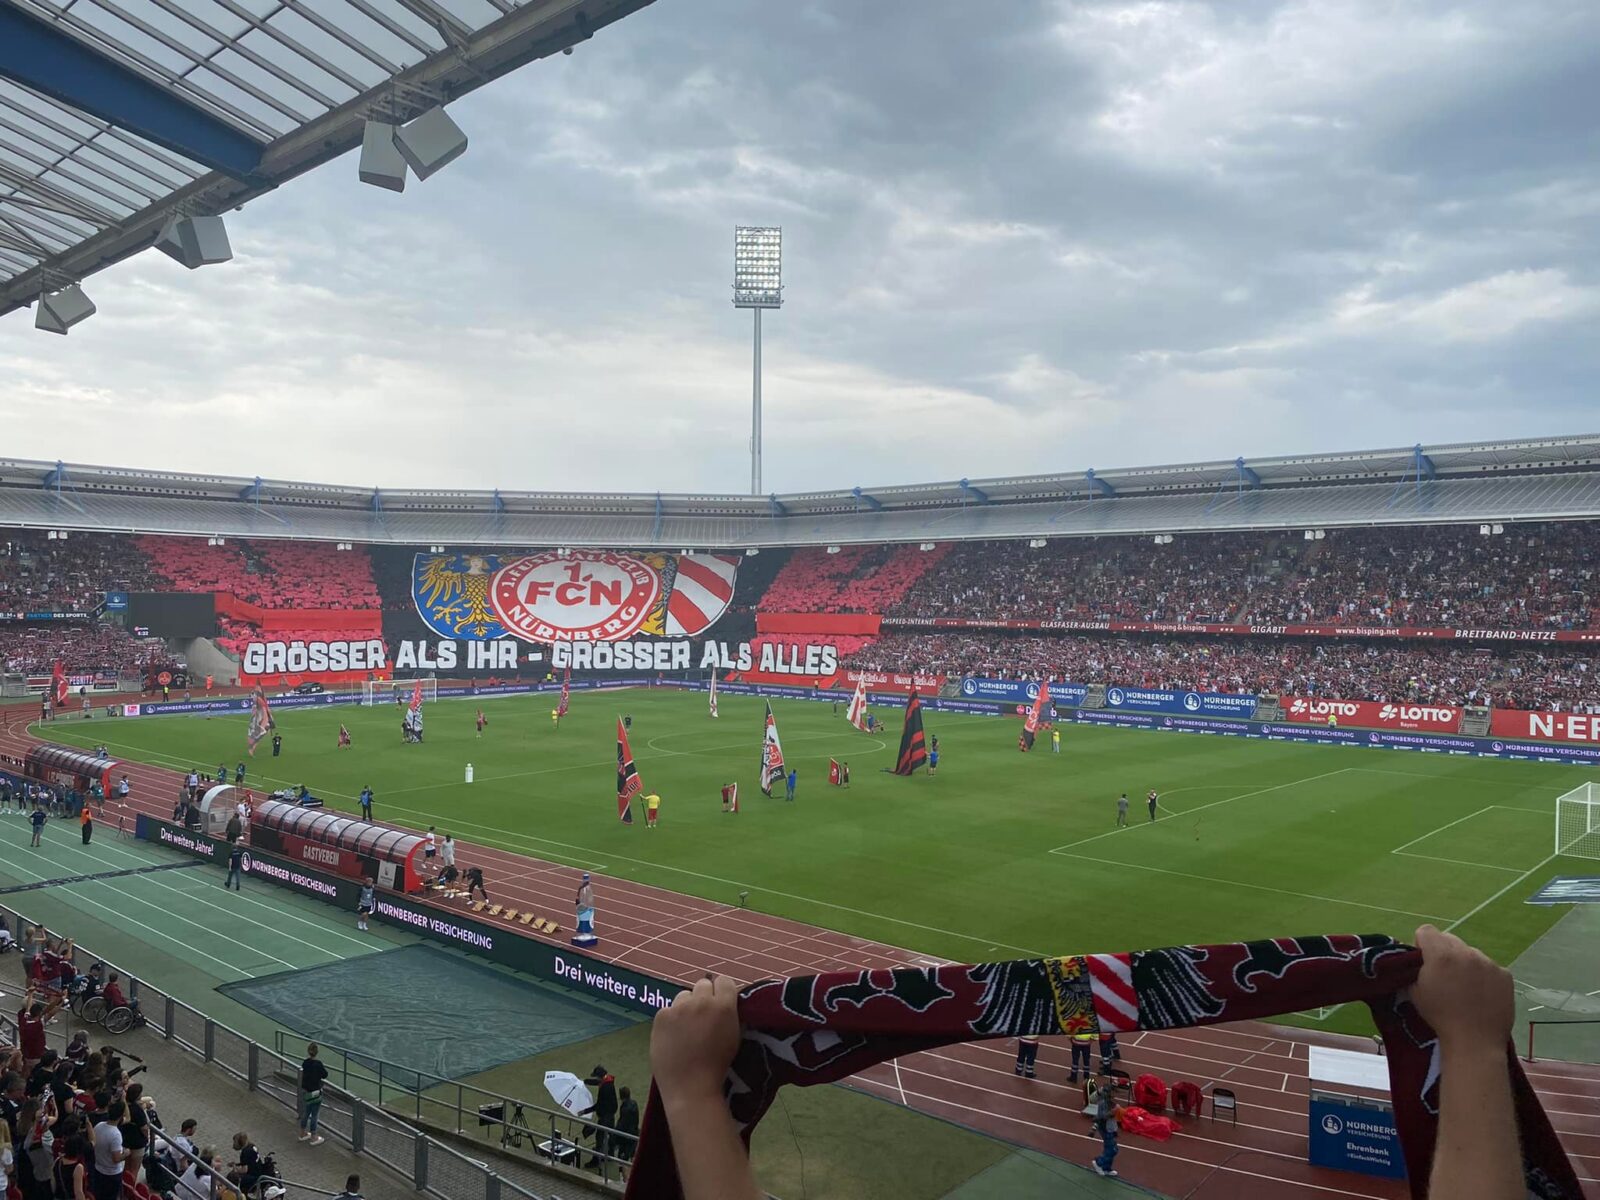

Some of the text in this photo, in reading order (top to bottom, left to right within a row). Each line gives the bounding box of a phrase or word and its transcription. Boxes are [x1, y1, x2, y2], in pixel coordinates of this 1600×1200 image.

[524, 580, 622, 606] FCN
[508, 605, 637, 641] NÜRNBERG
[1040, 620, 1110, 631] GLASFASER-AUSBAU
[1250, 625, 1287, 635] GIGABIT
[1335, 627, 1400, 638] www.bisping.net
[1455, 629, 1557, 641] BREITBAND-NETZE
[244, 640, 387, 674] GRÖSSER
[396, 640, 457, 669] ALS
[467, 640, 518, 669] IHR
[552, 640, 690, 670] GRÖSSER
[700, 640, 752, 671] ALS
[759, 643, 838, 676] ALLES
[978, 681, 1019, 691] NÜRNBERGER
[1126, 691, 1174, 702] NÜRNBERGER
[1203, 696, 1255, 707] NÜRNBERGER
[1203, 704, 1240, 712] VERSICHERUNG
[1309, 701, 1357, 717] LOTTO
[1400, 706, 1453, 723] LOTTO
[1173, 719, 1249, 731] NÜRNBERGER VERSICHERUNG
[1271, 726, 1355, 738] NÜRNBERGER VERSICHERUNG
[1381, 734, 1475, 748] NÜRNBERGER VERSICHERUNG
[1505, 744, 1554, 754] NÜRNBERGER
[160, 827, 215, 857] Drei weitere Jahre!
[303, 845, 340, 866] GASTVEREIN
[252, 859, 337, 897] NÜRNBERGER VERSICHERUNG
[377, 900, 493, 950] NÜRNBERGER VERSICHERUNG
[555, 956, 582, 982] Drei
[585, 972, 637, 1000] weitere
[1346, 1129, 1391, 1141] VERSICHERUNG
[1346, 1142, 1390, 1157] Ehrenbank
